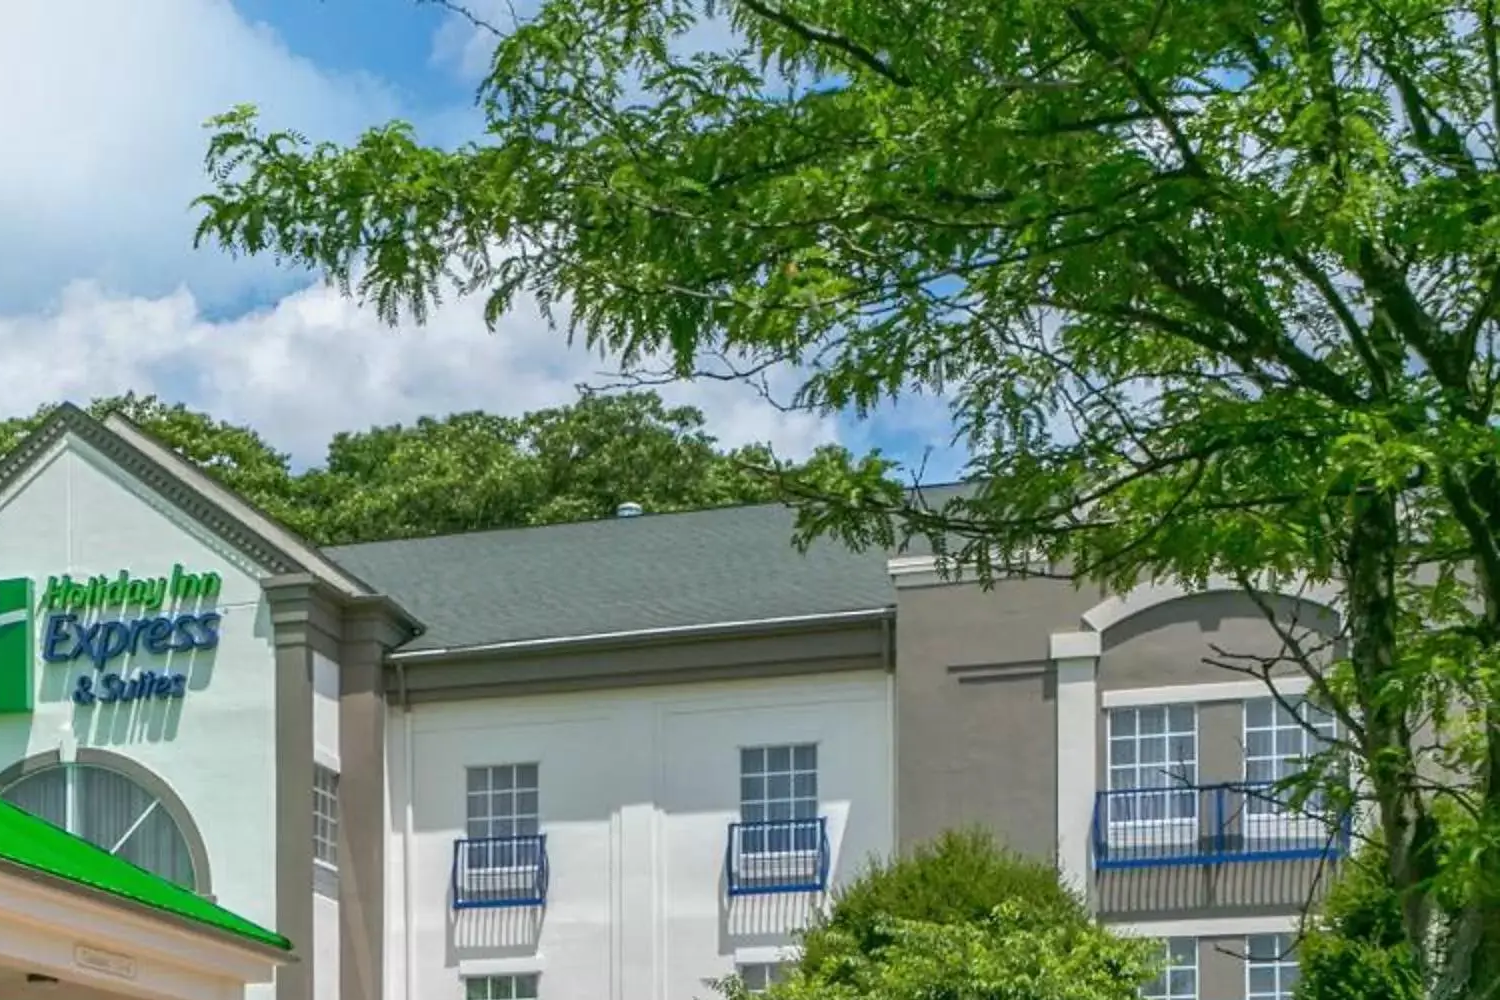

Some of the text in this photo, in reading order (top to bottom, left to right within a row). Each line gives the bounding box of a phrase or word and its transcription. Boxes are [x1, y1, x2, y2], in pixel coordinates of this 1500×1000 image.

[36, 563, 222, 610] Holiday Inn
[43, 612, 221, 672] Express
[73, 671, 186, 705] & Suites
